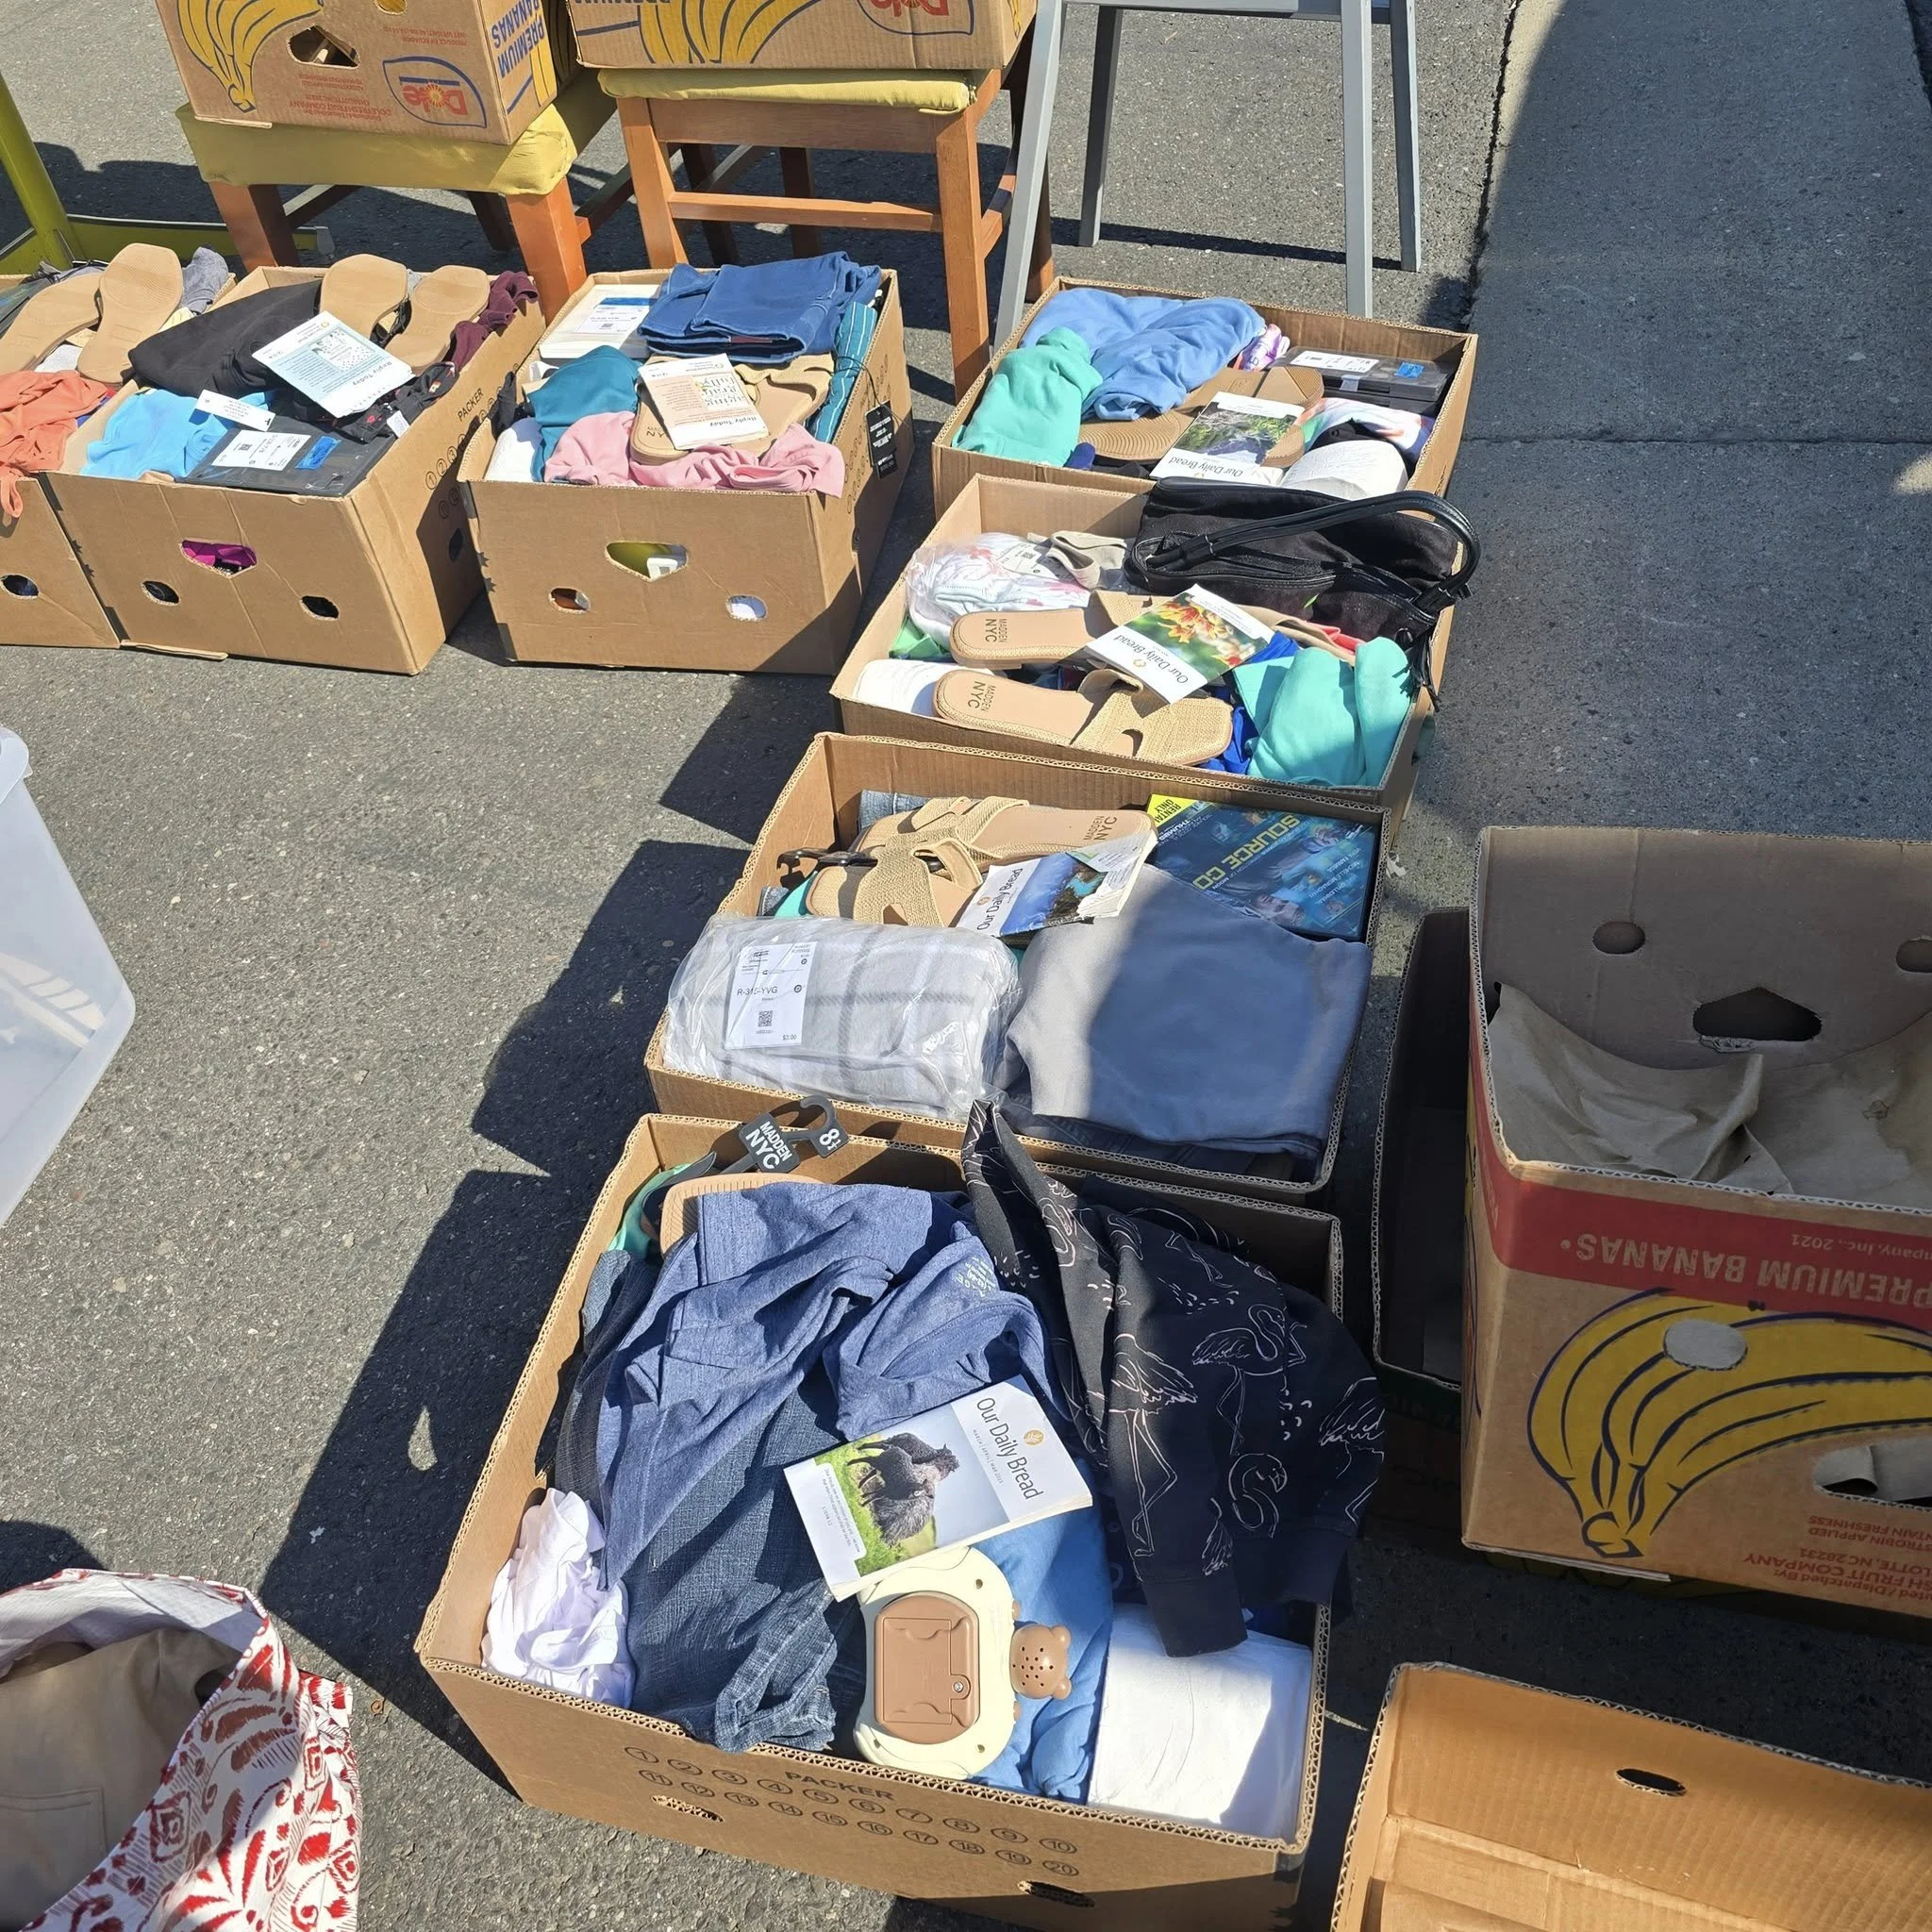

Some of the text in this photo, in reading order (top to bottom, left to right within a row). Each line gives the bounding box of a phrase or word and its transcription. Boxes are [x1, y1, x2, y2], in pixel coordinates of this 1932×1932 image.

[497, 16, 544, 78] PREMIUM
[402, 85, 468, 116] Dole
[458, 388, 484, 422] PACKER
[1168, 456, 1243, 477] Our Daily Bread
[985, 618, 997, 642] NYC
[998, 618, 1008, 642] MADDEN
[1113, 634, 1146, 655] Bread
[1141, 649, 1170, 670] Daily
[1166, 667, 1189, 685] Our
[967, 680, 986, 708] NYC
[980, 684, 996, 711] MADDEN
[1154, 798, 1174, 814] ONLY
[1083, 815, 1105, 841] MADDEN
[1093, 816, 1118, 841] NYC
[1158, 819, 1191, 841] THUMBS
[1221, 813, 1301, 870] SOURCE
[1191, 866, 1226, 891] CO
[976, 911, 993, 930] Our
[987, 887, 1009, 913] Daily
[998, 868, 1024, 894] Bread
[745, 1128, 780, 1169] NYC
[759, 1121, 793, 1161] MADDEN
[1790, 1233, 1835, 1250] 2021
[1577, 1233, 1932, 1307] PREMIUM BANANAS
[976, 1396, 1044, 1500] Our Daily Bread
[1808, 1515, 1890, 1535] FRESHNESS
[1808, 1527, 1868, 1542] APPLIED
[1799, 1548, 1848, 1563] 28231
[1849, 1556, 1873, 1566] NC
[1743, 1553, 1905, 1588] FRUIT COMPANY
[1774, 1569, 1799, 1582] By:
[1801, 1573, 1888, 1596] Dispatched
[785, 1772, 895, 1800] PACKER
